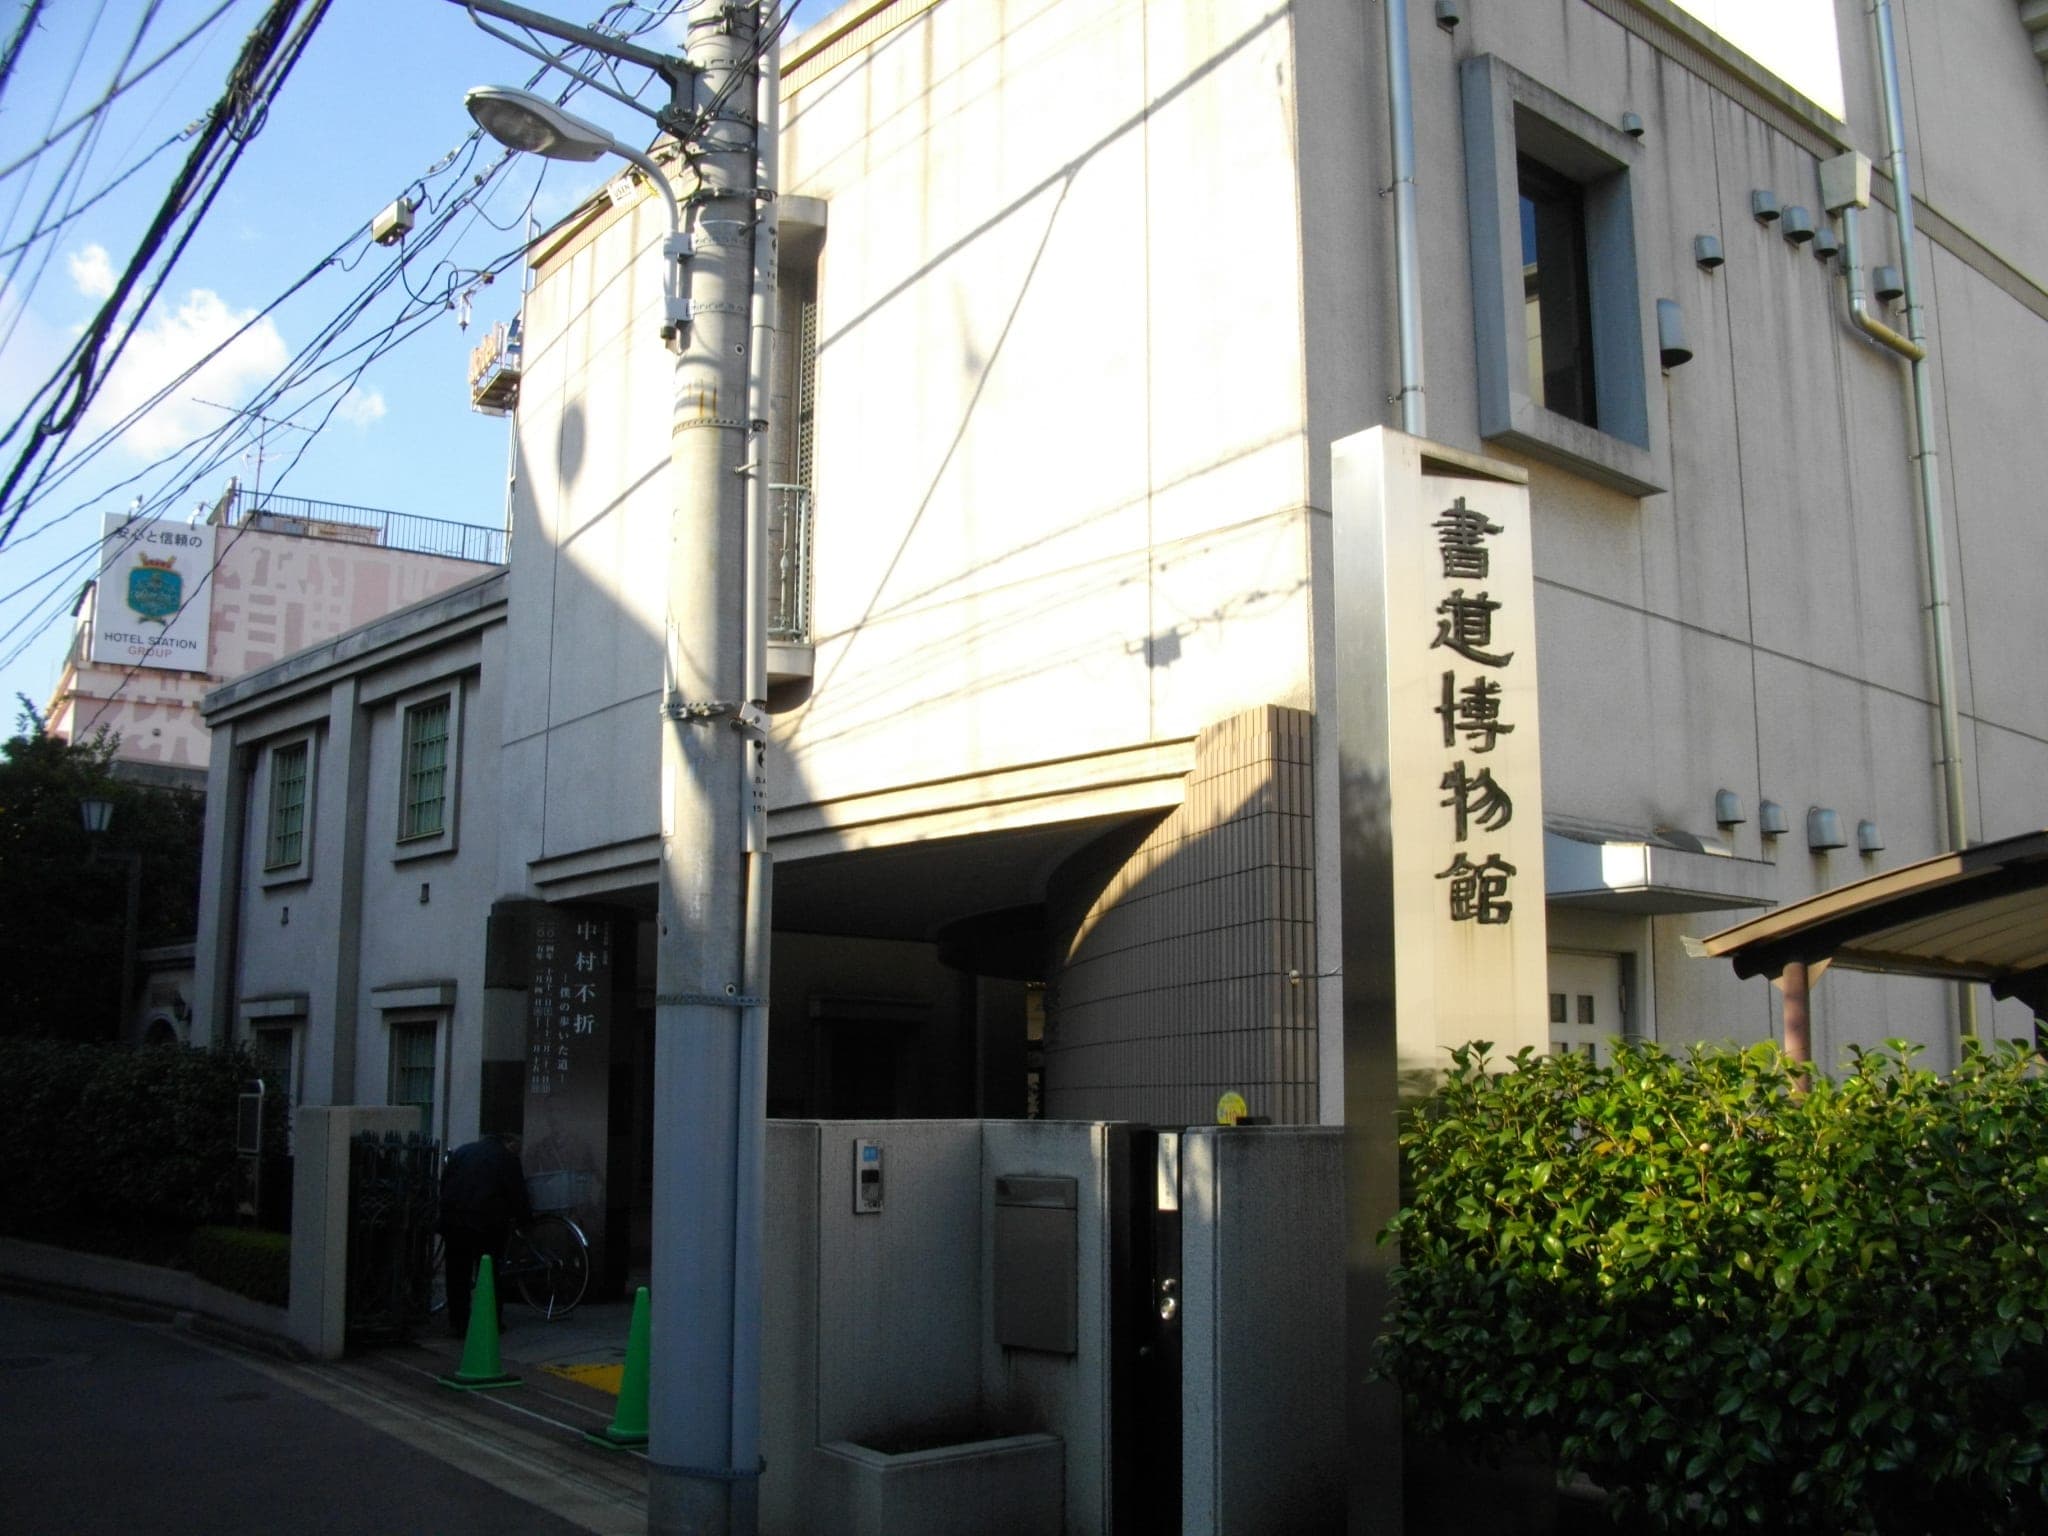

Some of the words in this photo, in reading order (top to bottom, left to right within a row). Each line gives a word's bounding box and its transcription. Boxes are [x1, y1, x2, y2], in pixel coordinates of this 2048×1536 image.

[104, 632, 144, 645] HOTEL
[148, 636, 197, 649] STATION
[127, 645, 173, 658] GROUP
[1430, 497, 1515, 925] 書道博物館
[574, 920, 597, 1034] 中村不折
